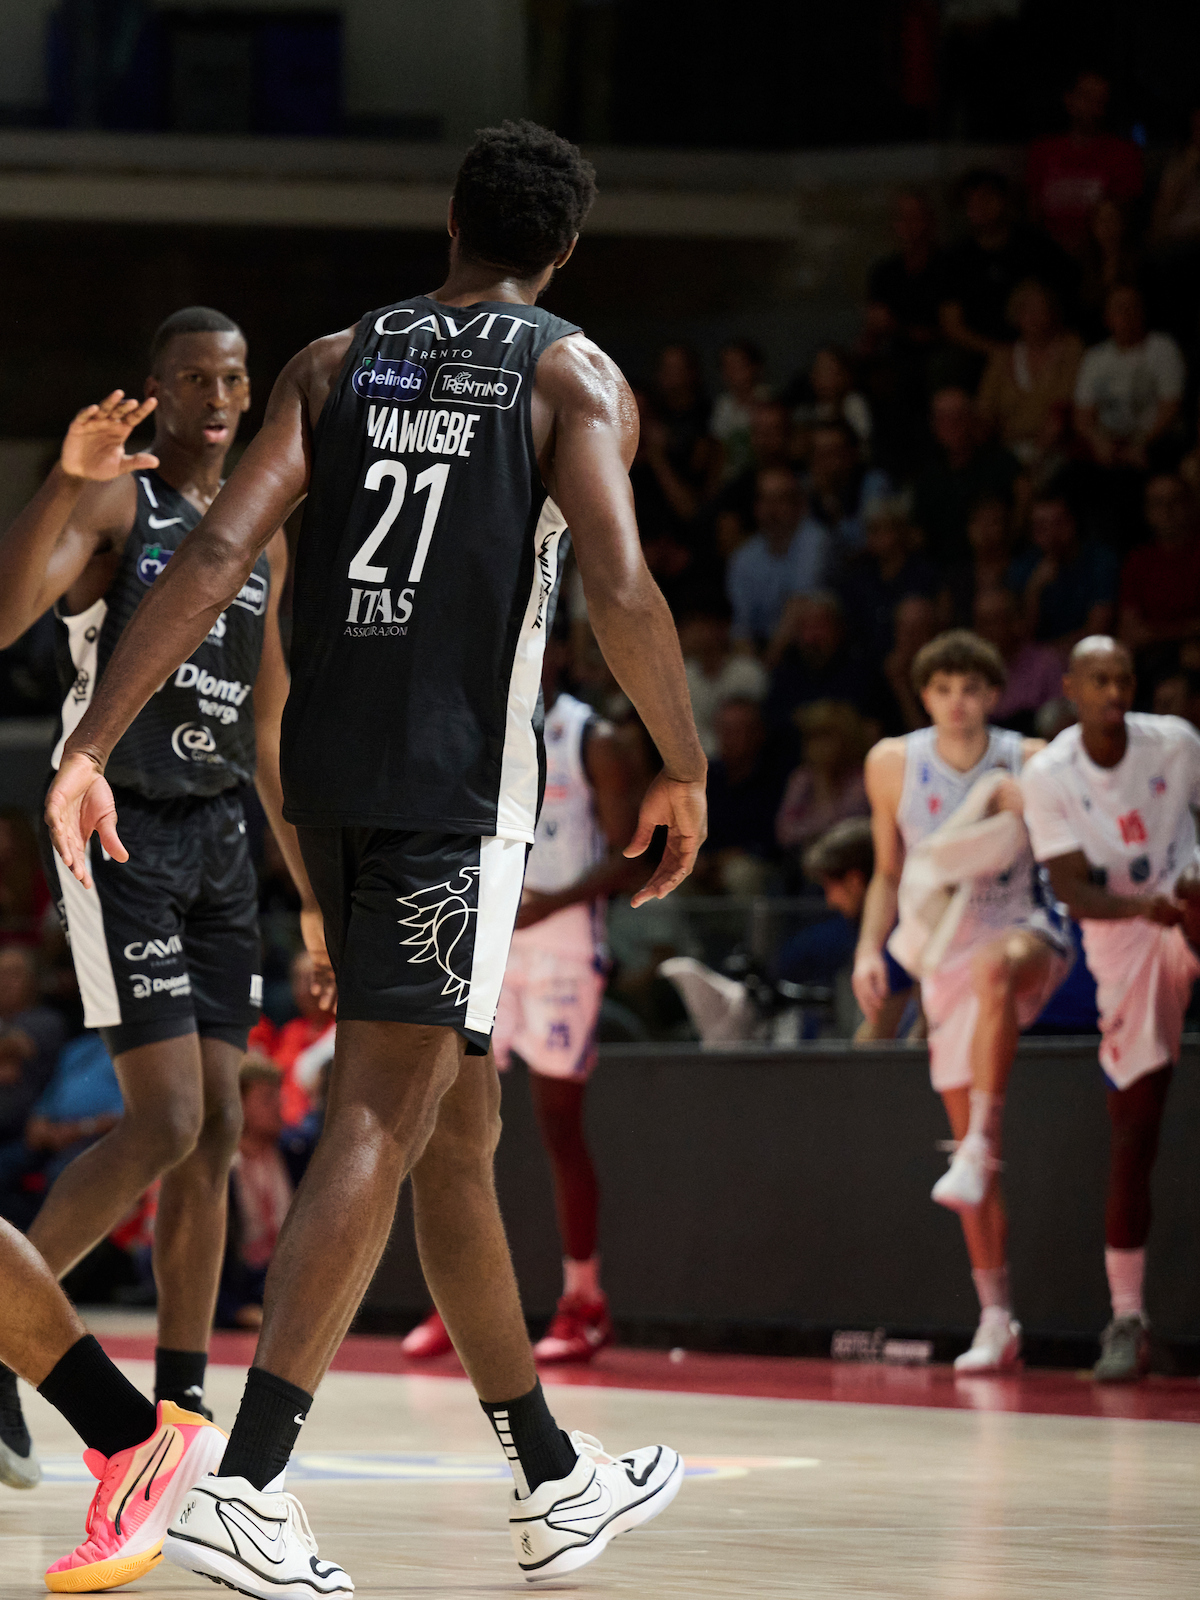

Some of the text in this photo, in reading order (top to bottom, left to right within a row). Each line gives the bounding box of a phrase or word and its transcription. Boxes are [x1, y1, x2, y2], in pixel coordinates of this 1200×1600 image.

[374, 309, 539, 344] CAVIT
[409, 346, 473, 361] TRENTO
[441, 374, 508, 397] TRENTINO
[348, 459, 450, 583] 21
[345, 588, 415, 623] ITAS
